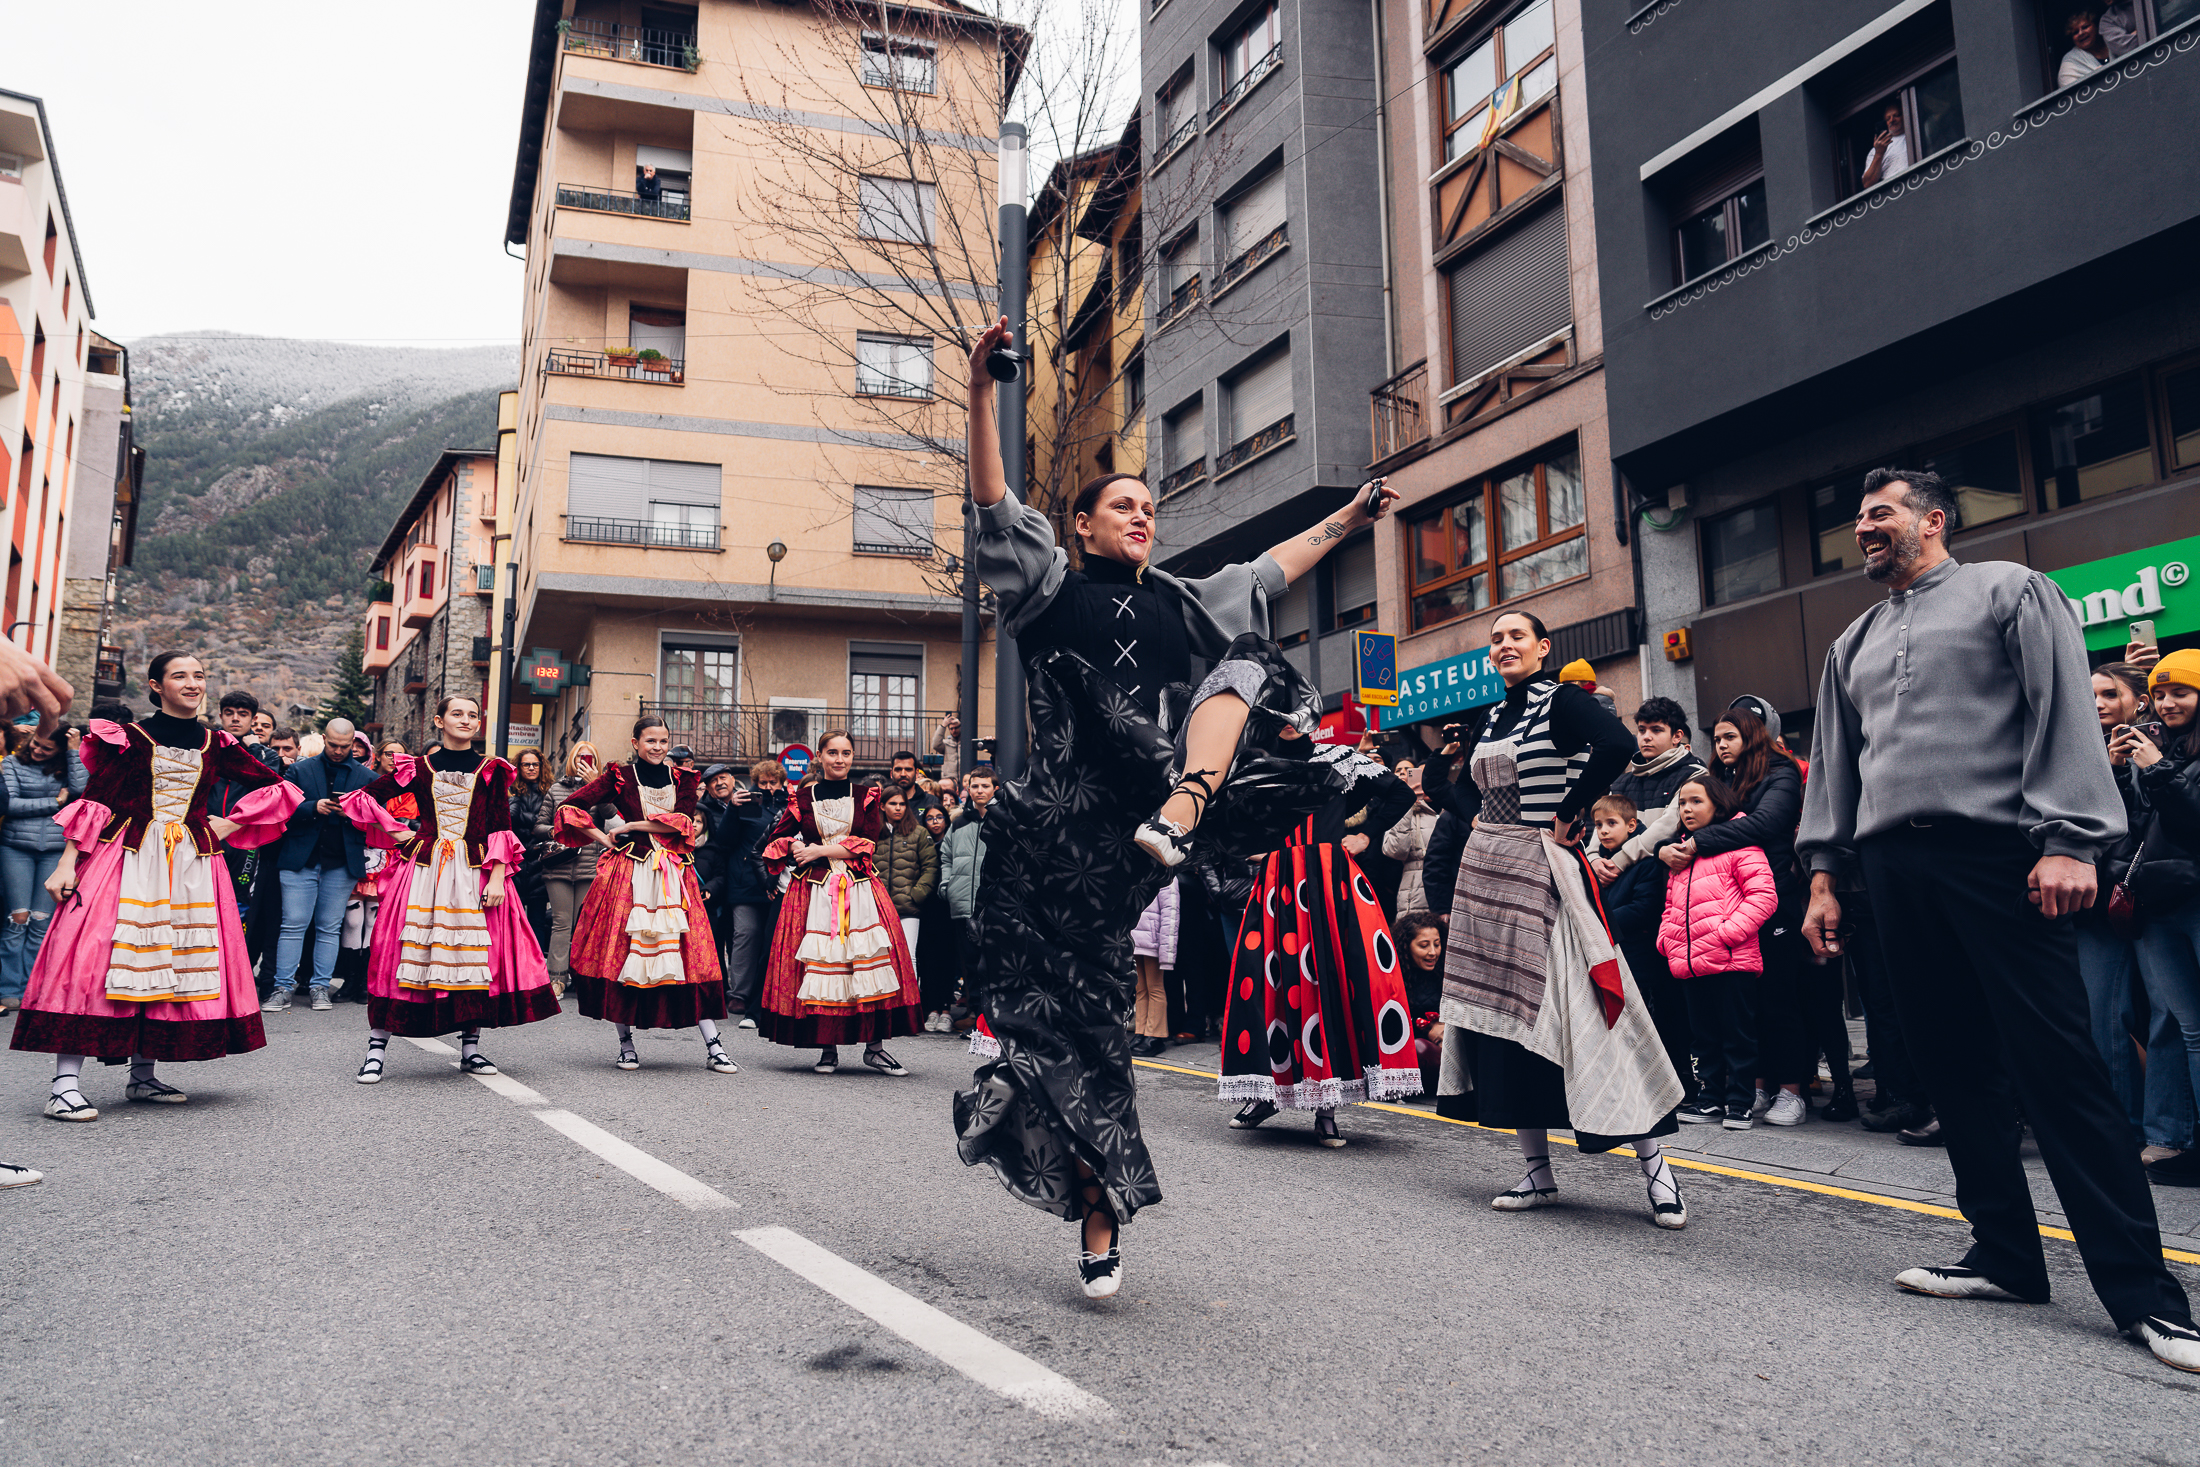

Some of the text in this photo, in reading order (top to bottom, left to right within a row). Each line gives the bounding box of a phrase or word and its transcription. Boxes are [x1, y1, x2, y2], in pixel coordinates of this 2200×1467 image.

[1399, 655, 1497, 699] ASTEUR
[1388, 682, 1498, 721] LABORATORI
[1309, 725, 1335, 742] ident
